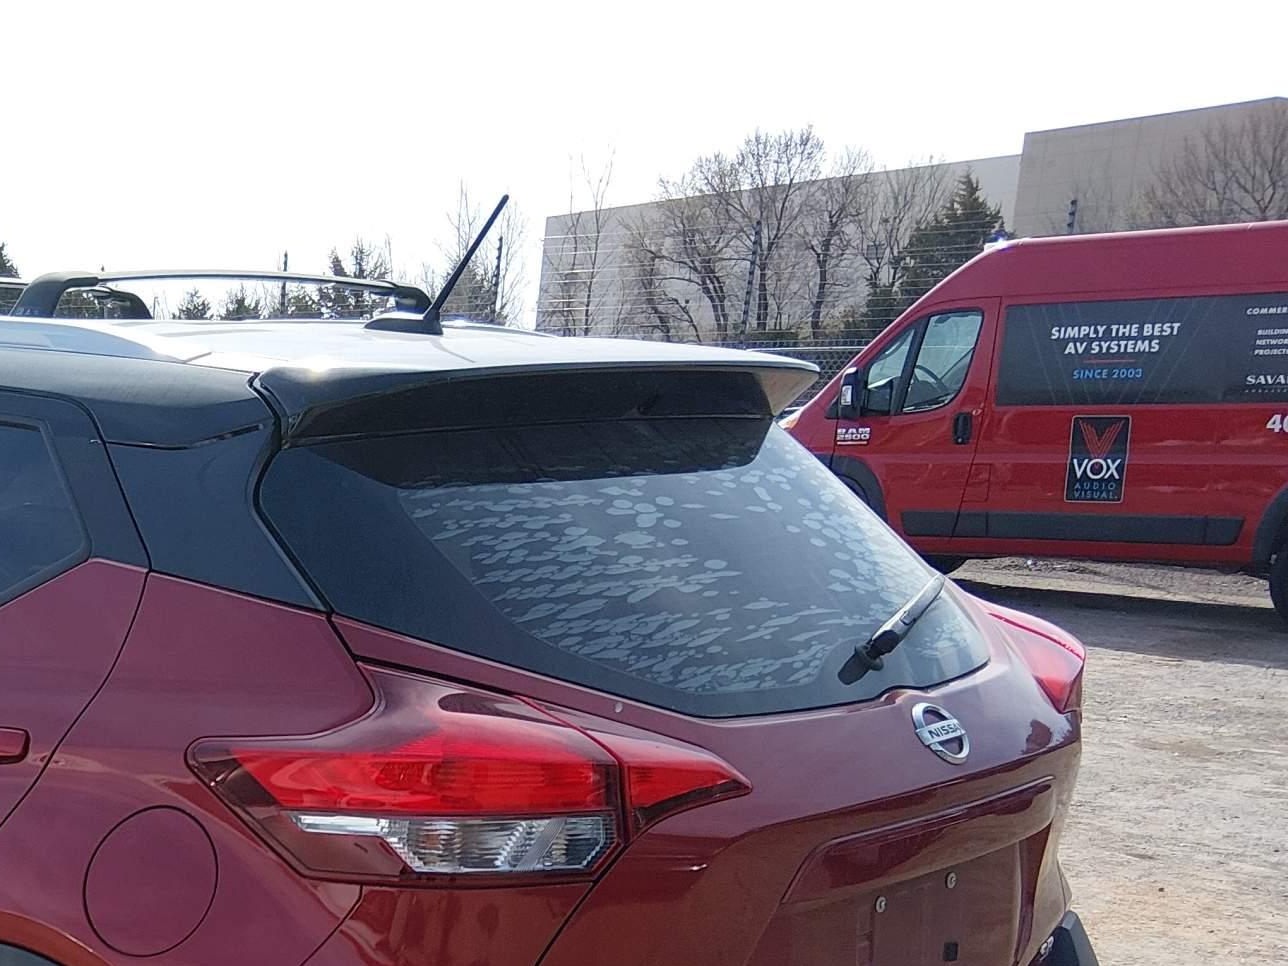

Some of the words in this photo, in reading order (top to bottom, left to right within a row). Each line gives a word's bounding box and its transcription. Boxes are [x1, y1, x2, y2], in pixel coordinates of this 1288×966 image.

[1051, 325, 1107, 339] SIMPLY
[1111, 324, 1139, 337] THE
[1143, 322, 1181, 336] BEST
[1064, 342, 1087, 354] AV
[1091, 340, 1160, 353] SYSTEMS
[1073, 369, 1108, 379] SINCE
[1112, 368, 1142, 378] 2003
[1073, 458, 1122, 480] VOX
[1074, 482, 1116, 490] AUDIO
